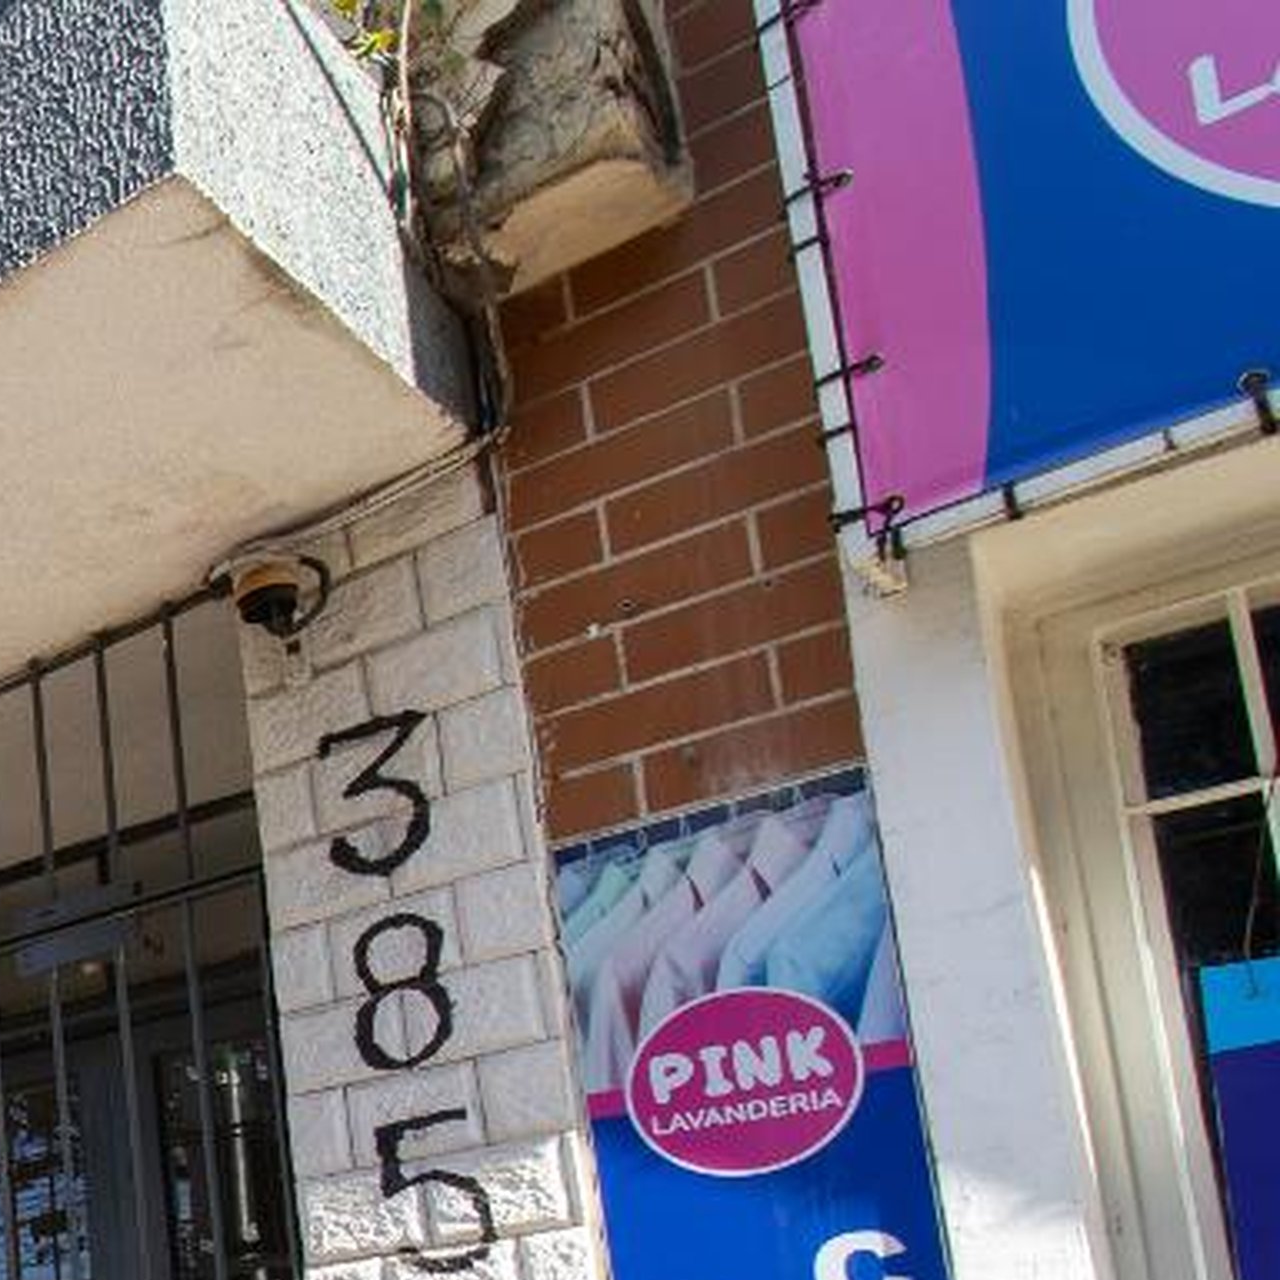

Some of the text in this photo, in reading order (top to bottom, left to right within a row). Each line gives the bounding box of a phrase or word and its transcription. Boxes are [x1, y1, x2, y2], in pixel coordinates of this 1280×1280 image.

[1188, 54, 1280, 126] L
[317, 709, 499, 1274] 385
[648, 1025, 834, 1106] PINK
[650, 1086, 844, 1138] LAVANDERIA
